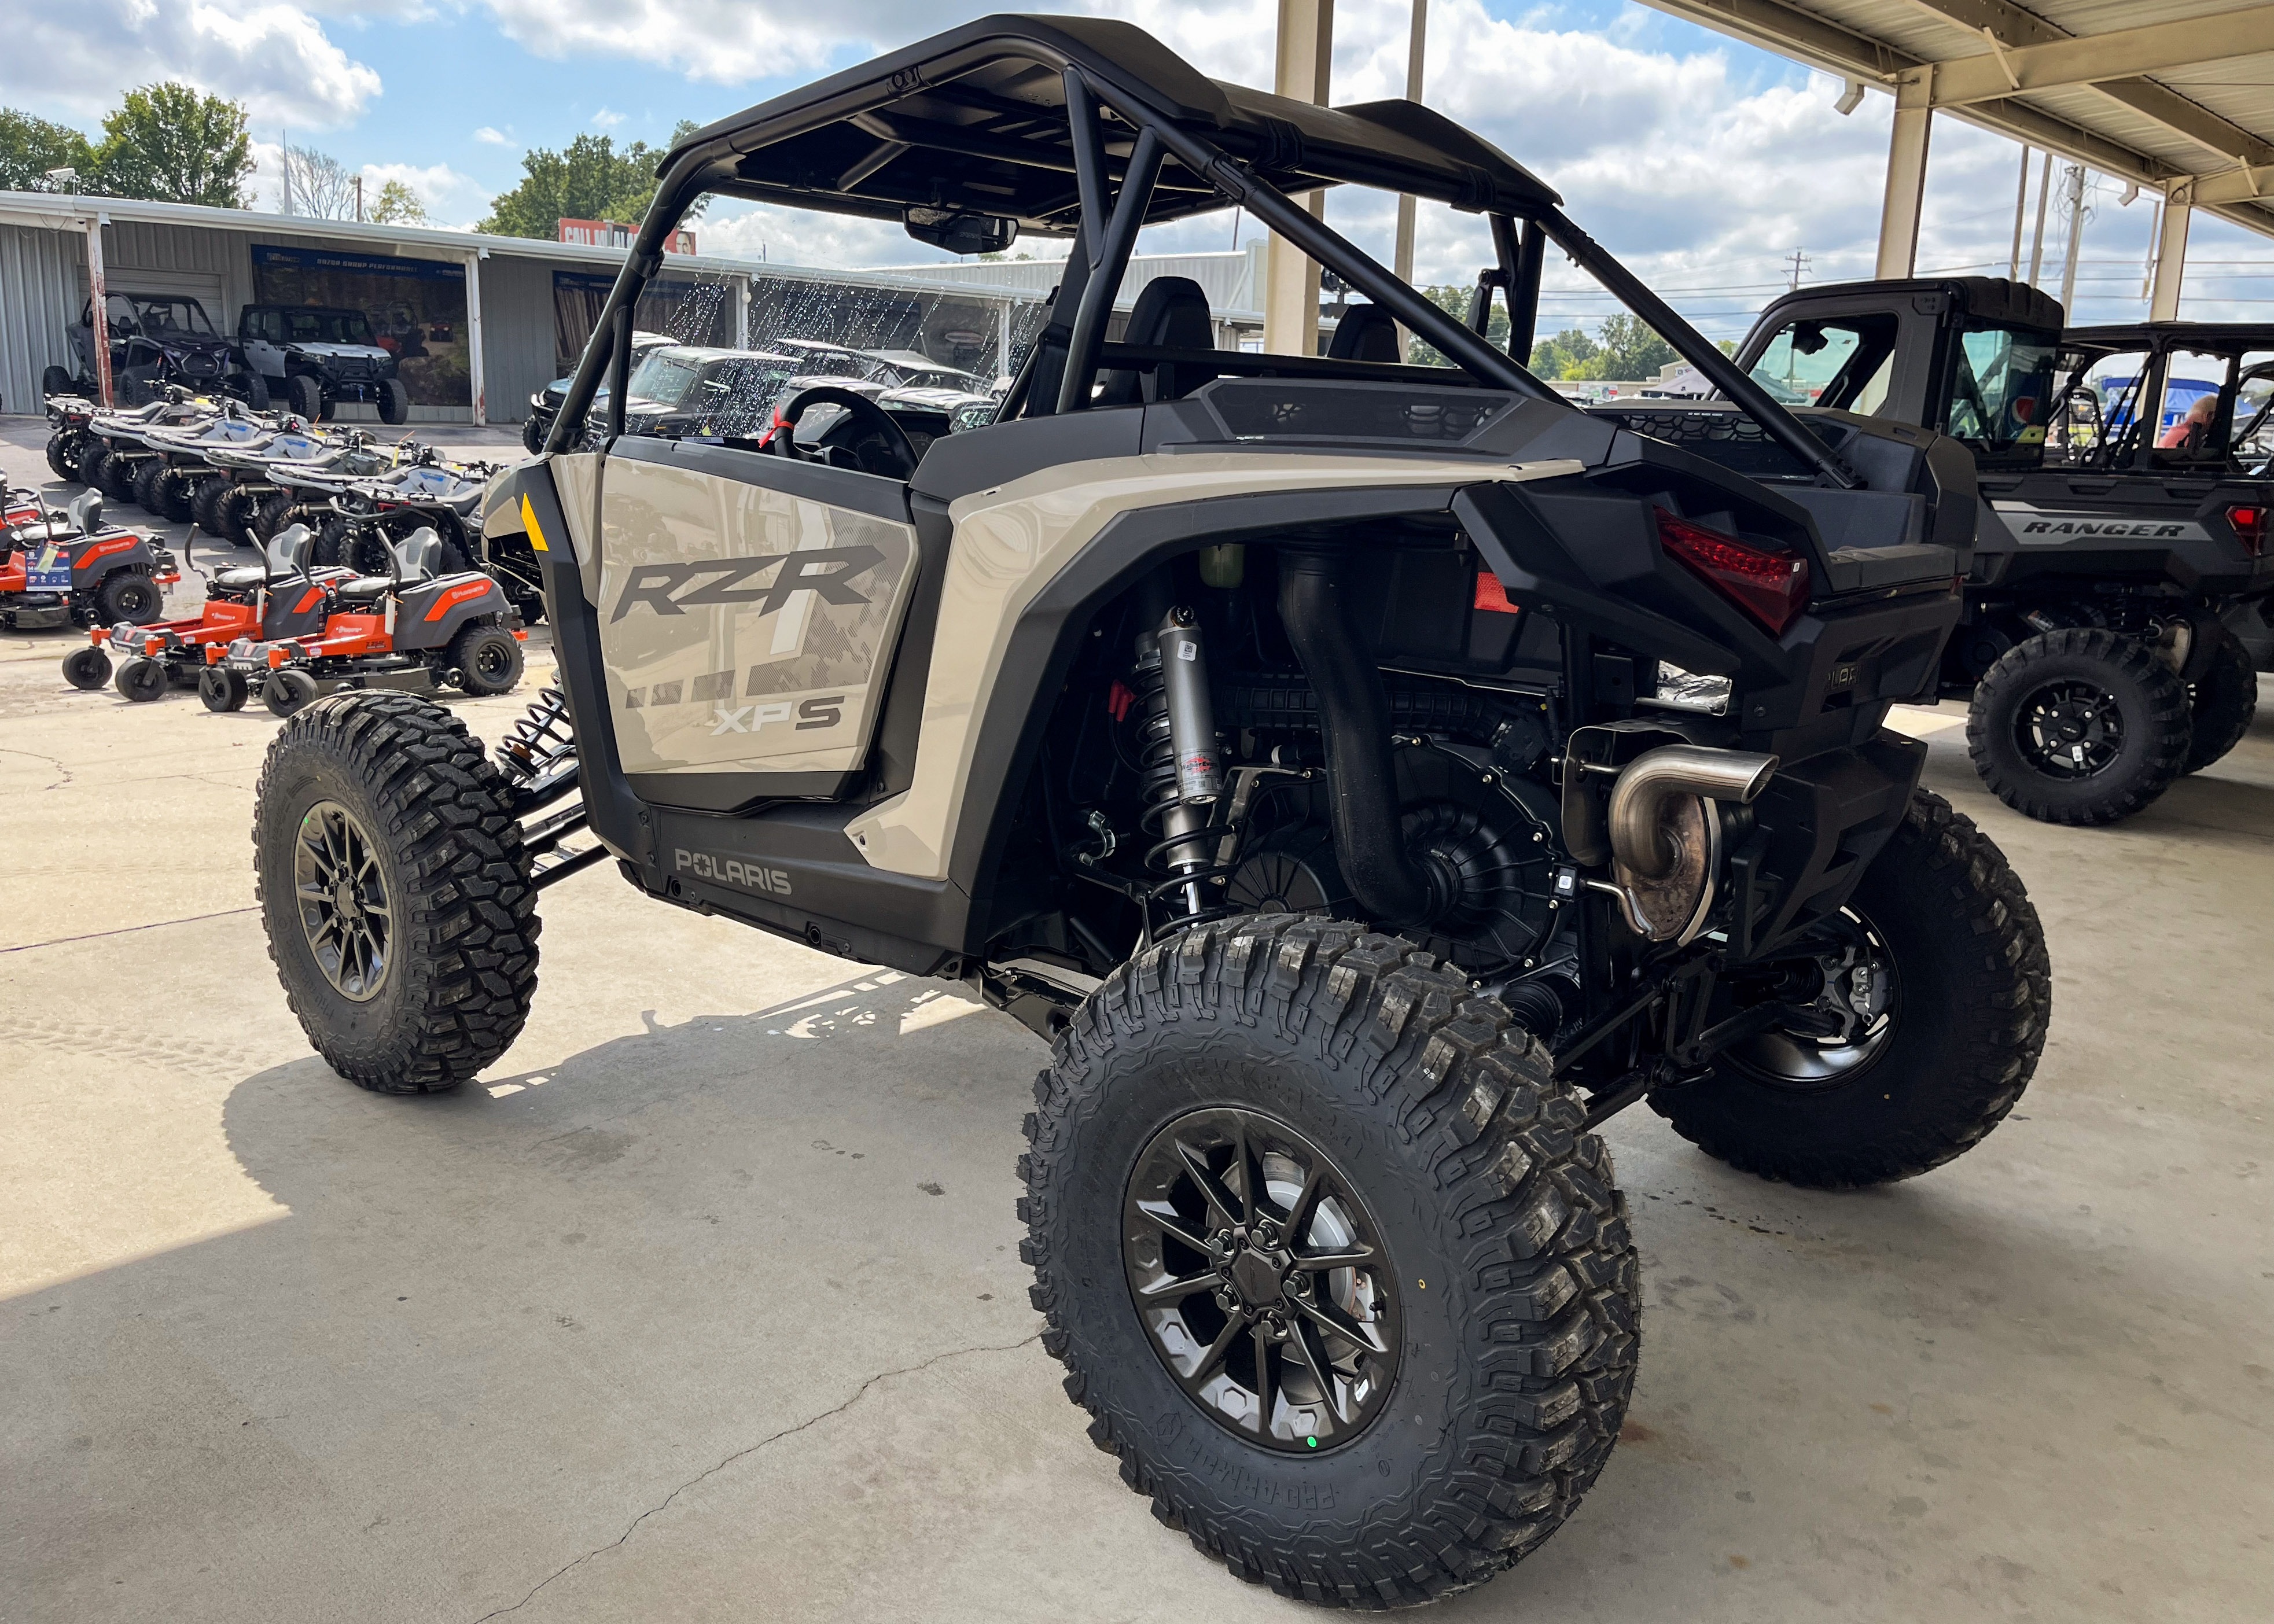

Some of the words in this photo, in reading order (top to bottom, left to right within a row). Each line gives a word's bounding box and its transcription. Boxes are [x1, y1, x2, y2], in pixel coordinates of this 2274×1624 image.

[2023, 521, 2185, 537] RANGER
[609, 545, 887, 625] RZR
[675, 848, 792, 896] POLARIS
